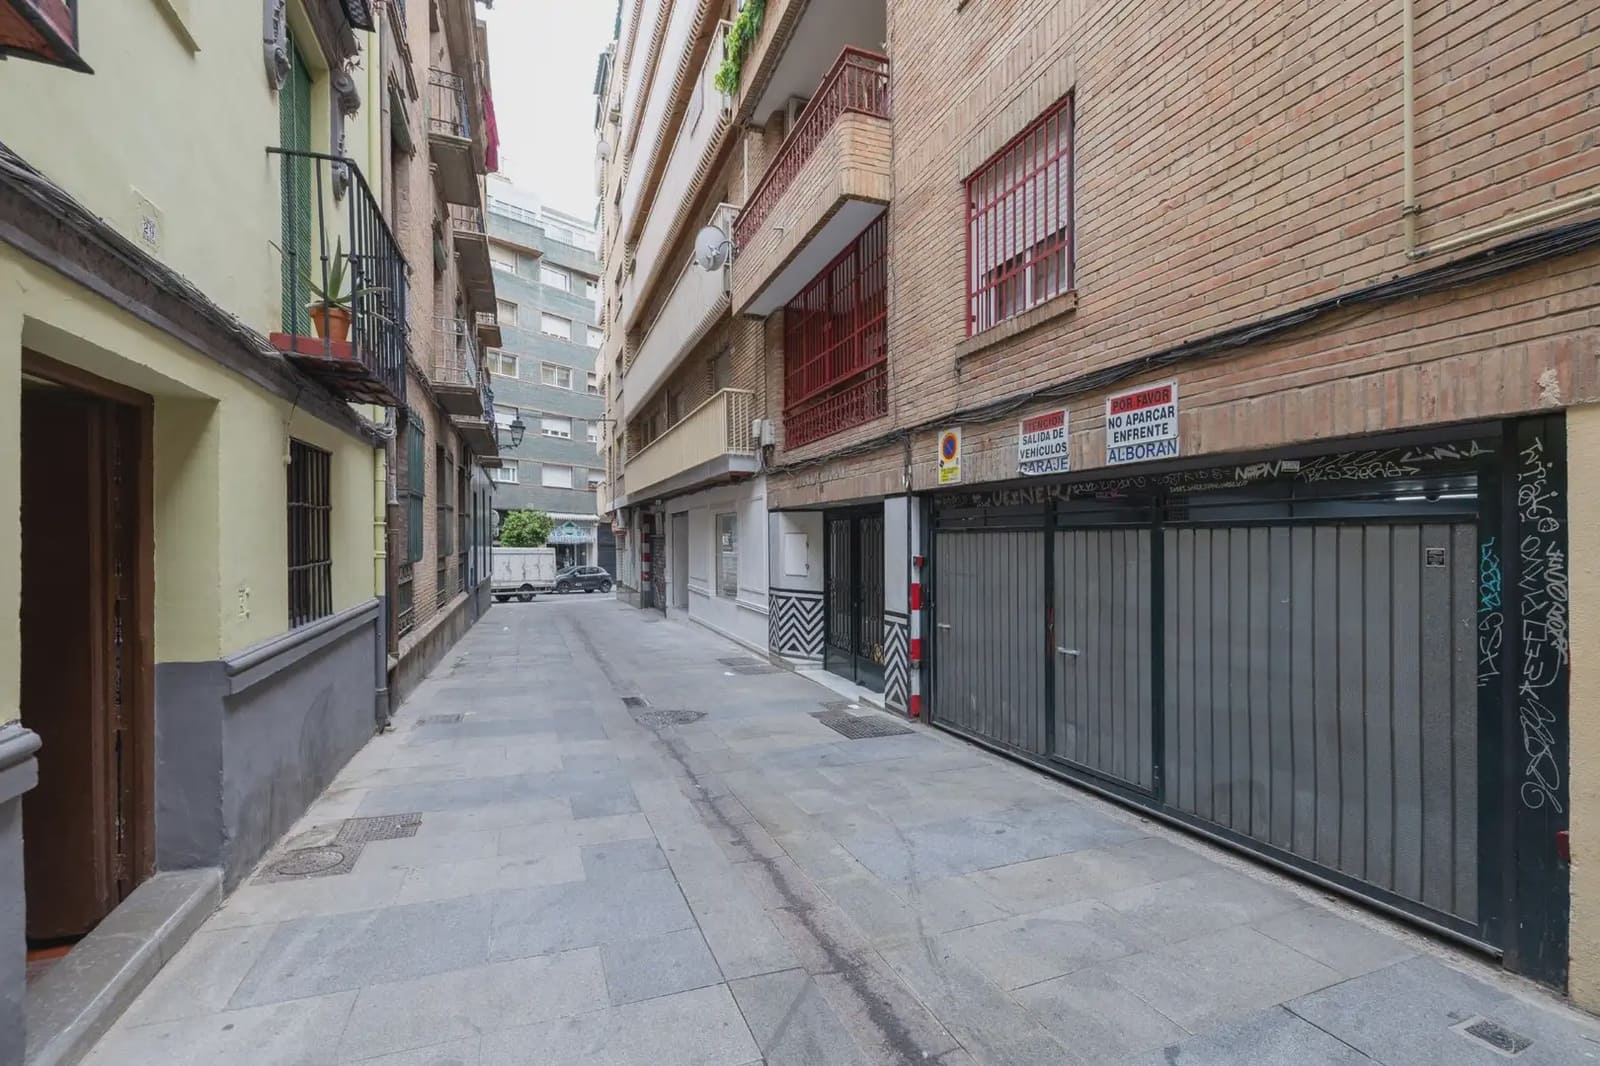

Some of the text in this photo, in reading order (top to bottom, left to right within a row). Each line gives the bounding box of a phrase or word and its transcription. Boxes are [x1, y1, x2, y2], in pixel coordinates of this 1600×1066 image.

[1112, 389, 1169, 412] POR FAVOR
[1108, 405, 1175, 430] NO APARCAR
[1022, 428, 1064, 446] SALIDA DE
[1113, 422, 1169, 443] ENFRENTE
[1108, 440, 1177, 463] ALBORAN
[1019, 456, 1068, 472] GARAJE
